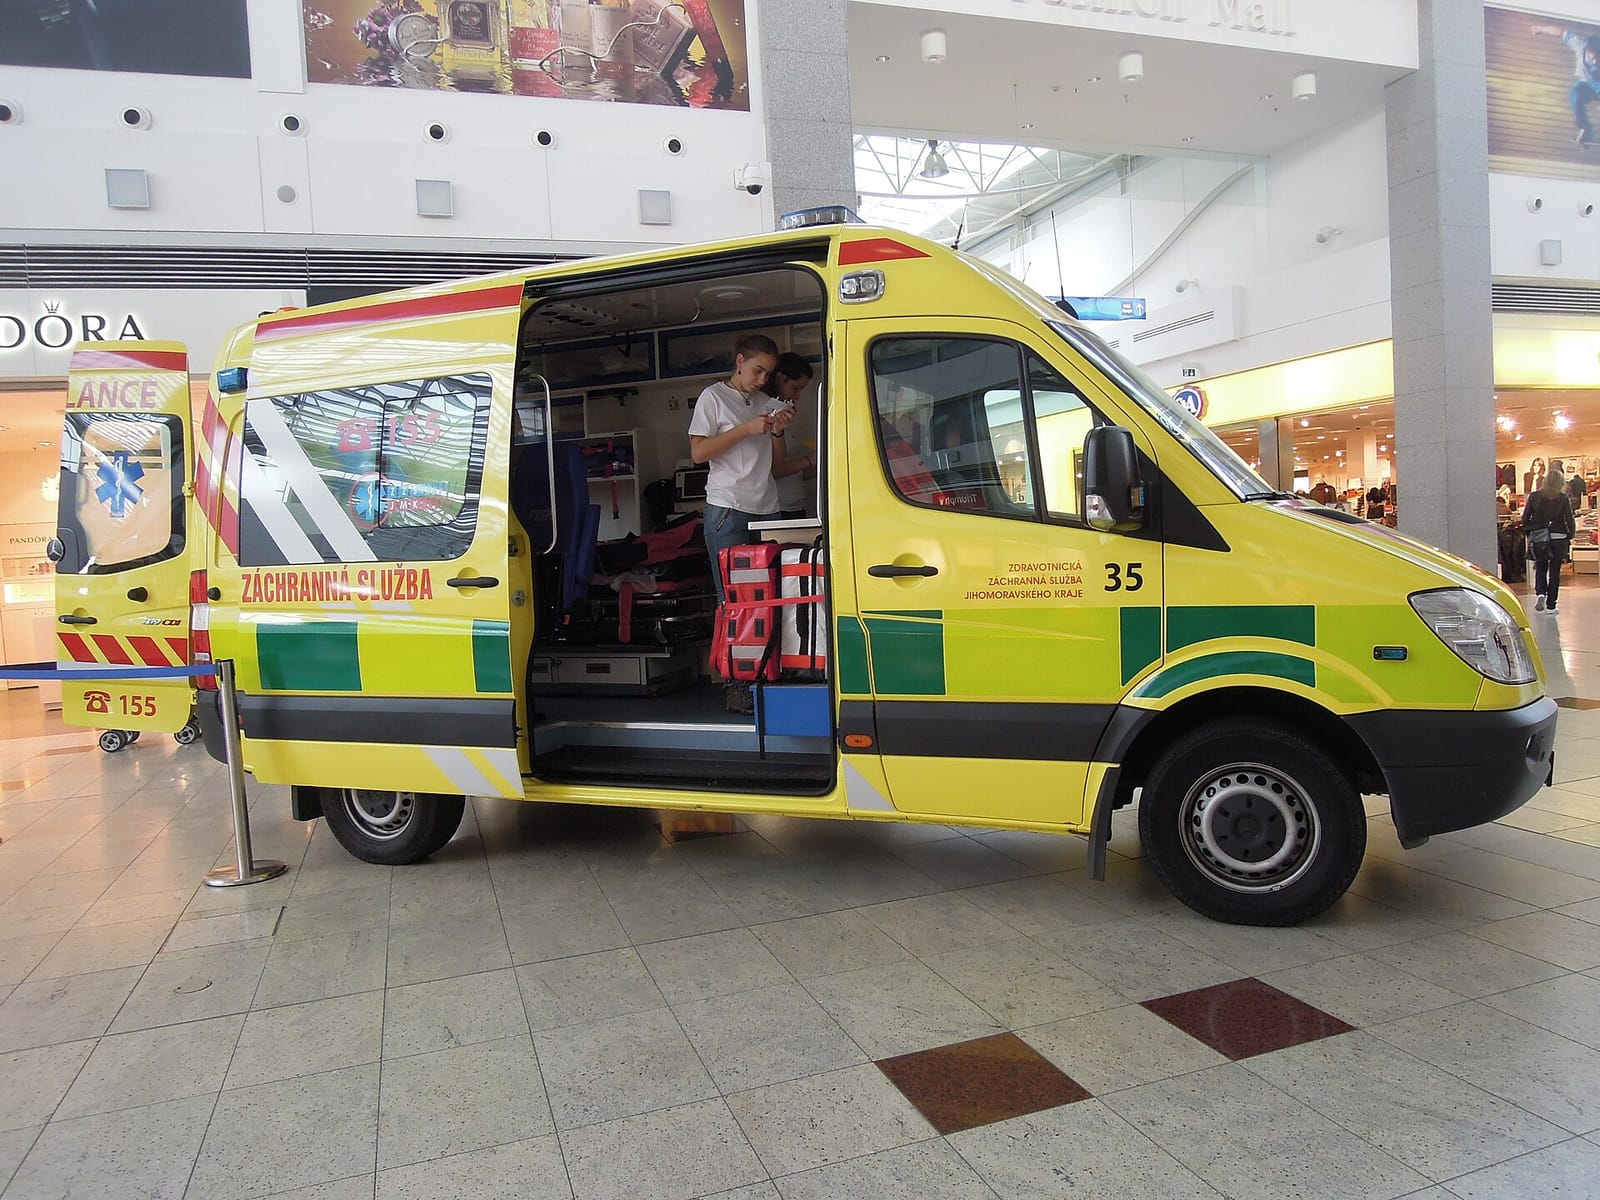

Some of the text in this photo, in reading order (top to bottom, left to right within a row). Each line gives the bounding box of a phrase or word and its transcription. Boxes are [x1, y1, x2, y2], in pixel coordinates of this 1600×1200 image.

[385, 412, 441, 446] 155
[1008, 560, 1083, 573] ZDRAVOTNICKÁ
[1104, 562, 1144, 592] 35
[241, 563, 433, 603] ZÁCHRANNÁ SLUŽBA
[988, 574, 1083, 586] ZÁCHRANNÁ SLUŽBA
[964, 588, 1084, 600] JIHOMORAVSKÉHO KRAJE
[119, 694, 157, 717] 155
